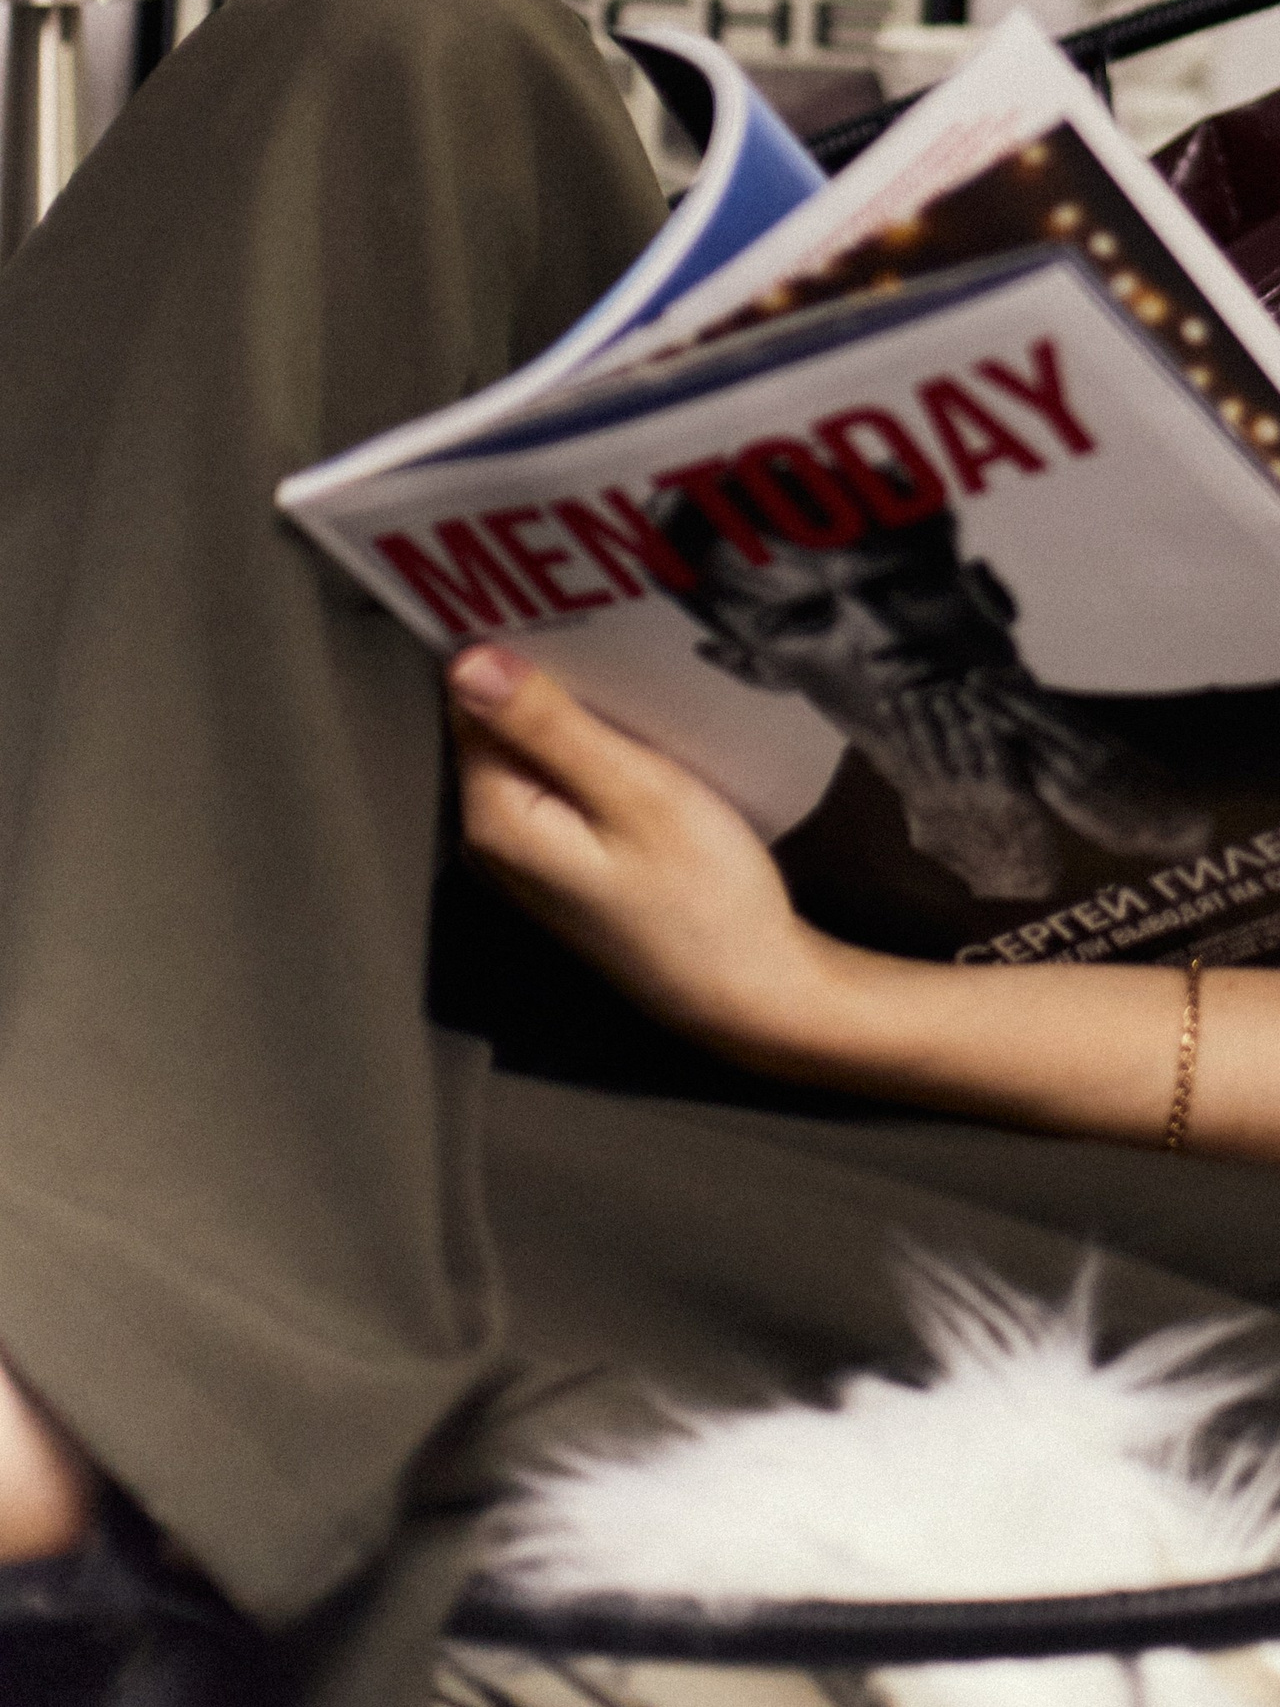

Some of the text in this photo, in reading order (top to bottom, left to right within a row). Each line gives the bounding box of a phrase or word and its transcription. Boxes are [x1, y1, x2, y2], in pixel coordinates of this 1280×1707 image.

[372, 334, 1100, 636] MEN TODAY
[953, 882, 1150, 964] СЕРГЕЙ
[1226, 877, 1265, 905] НА
